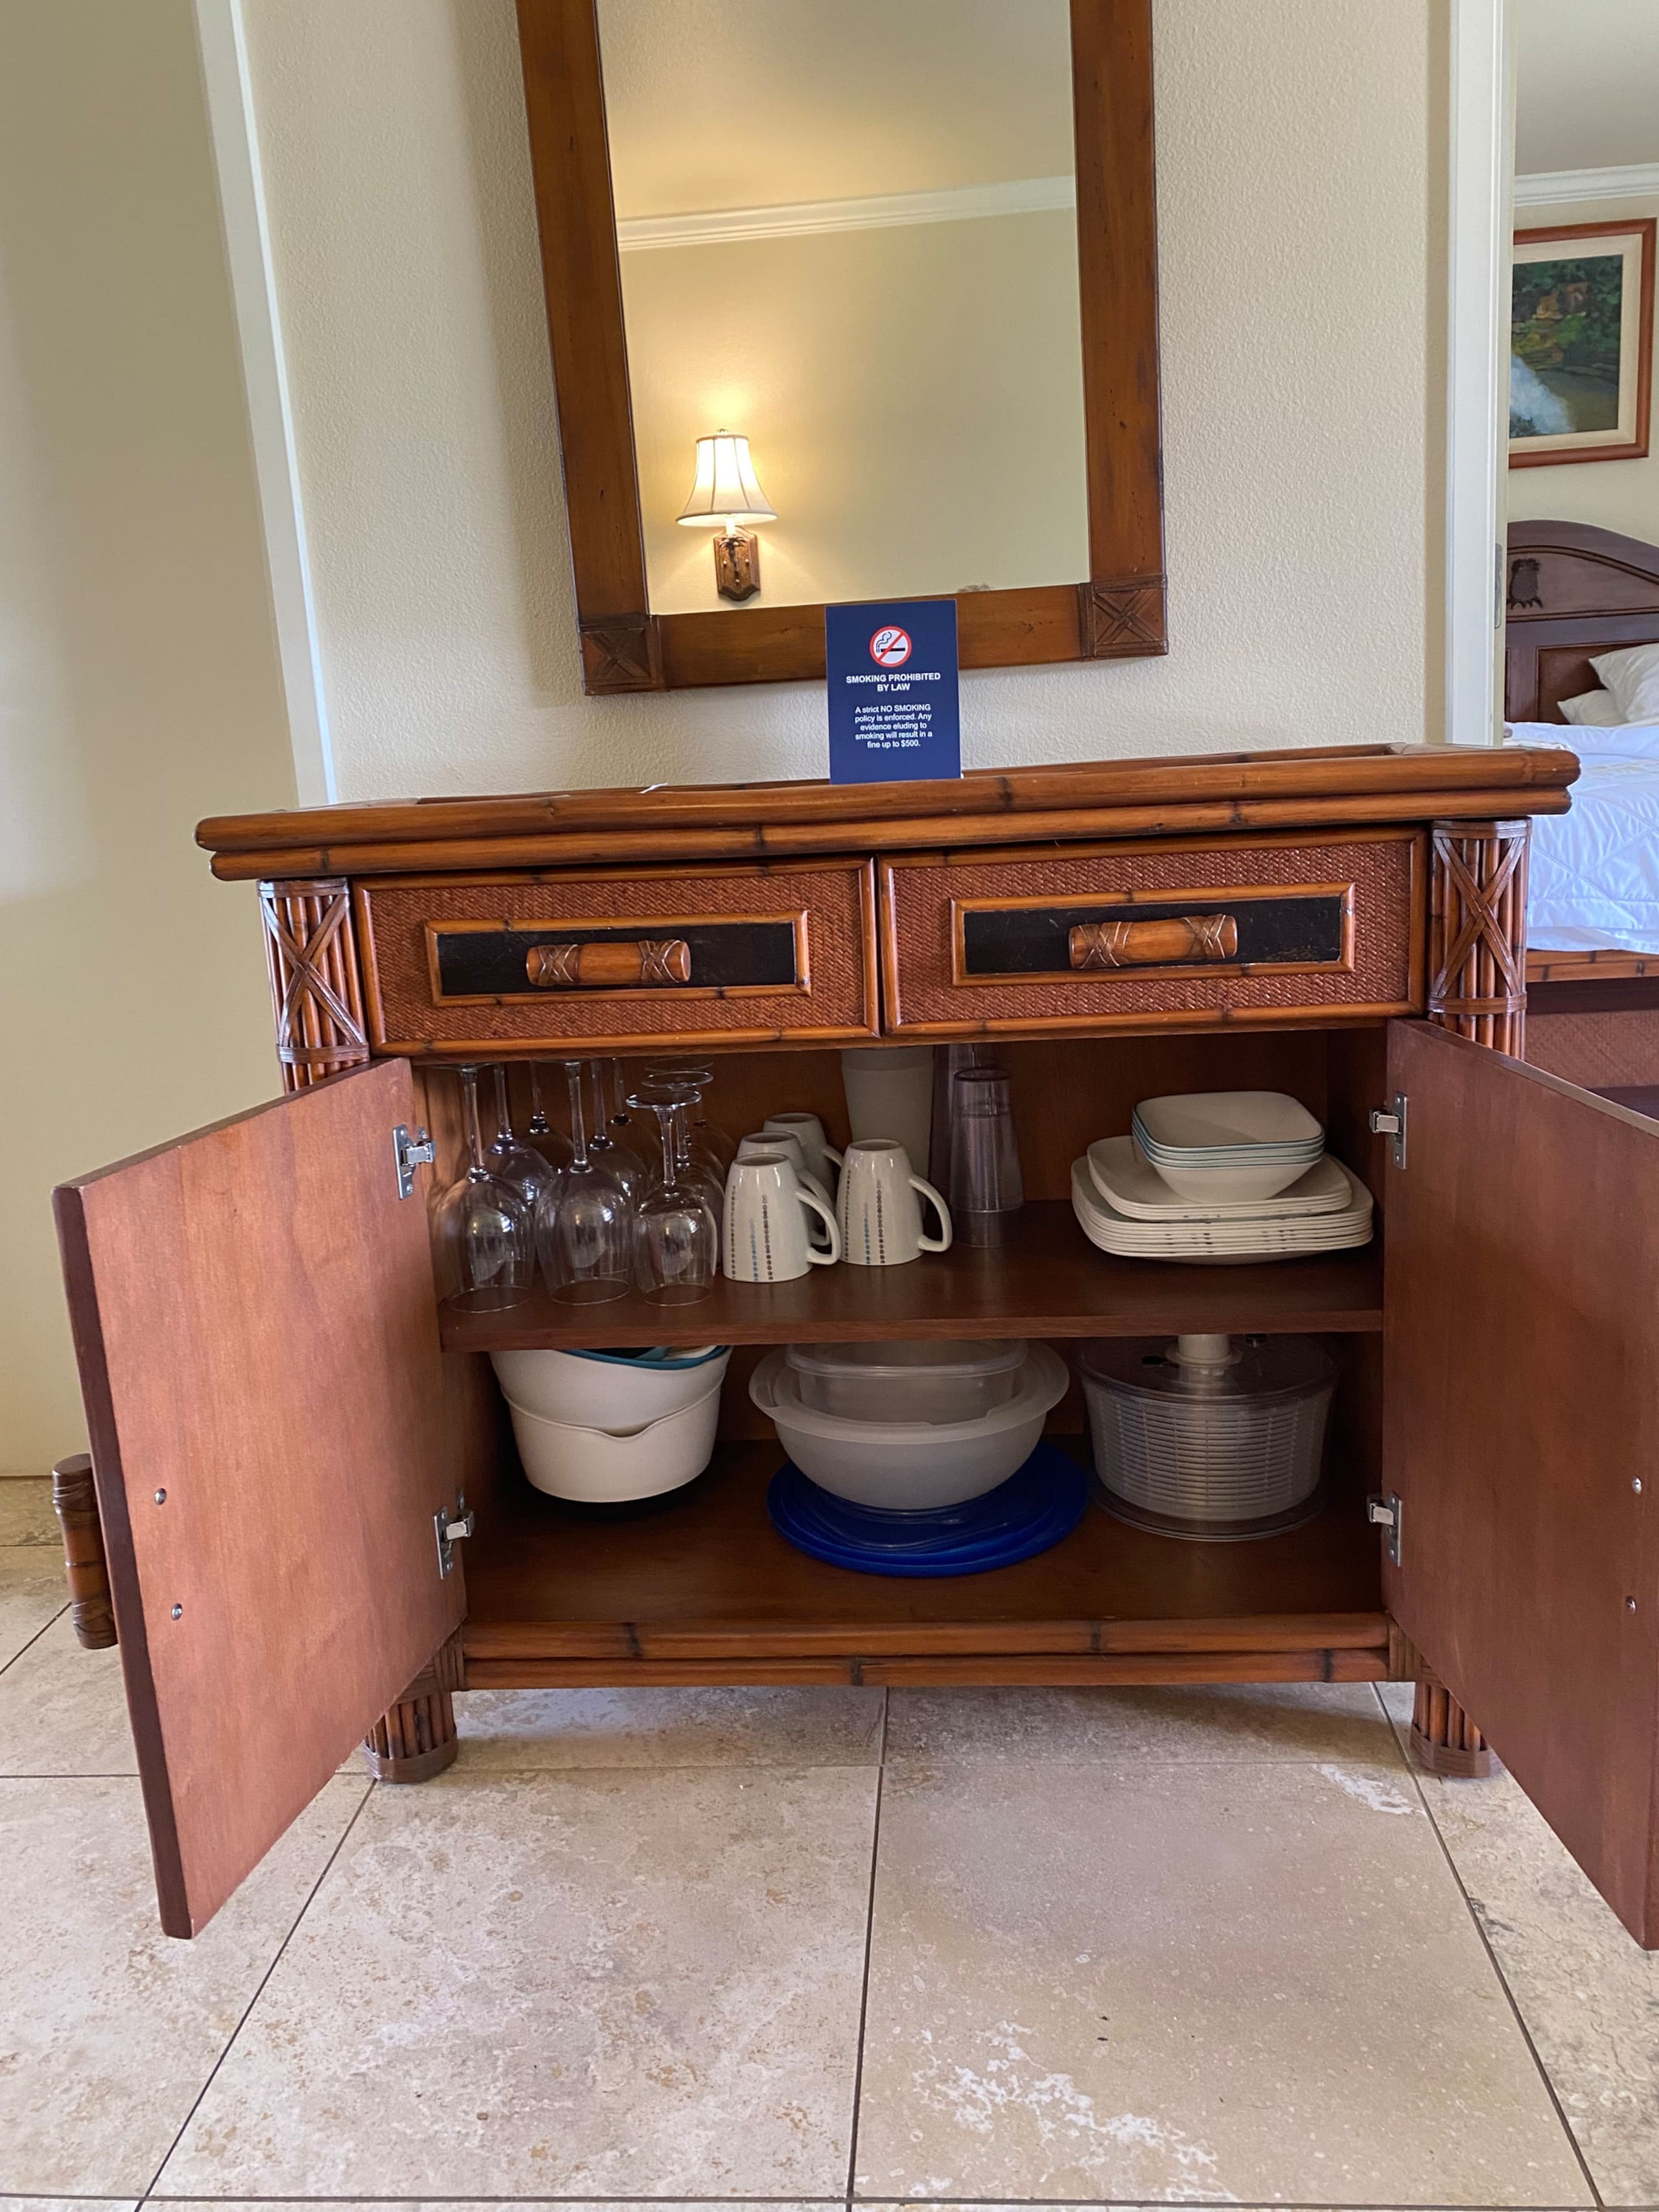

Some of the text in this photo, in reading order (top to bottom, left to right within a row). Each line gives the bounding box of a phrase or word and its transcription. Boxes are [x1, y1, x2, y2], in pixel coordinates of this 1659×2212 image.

[846, 673, 941, 683] SMOKING PROHIBITED
[855, 715, 875, 724] policy
[918, 712, 932, 721] Any
[855, 732, 885, 741] smoking
